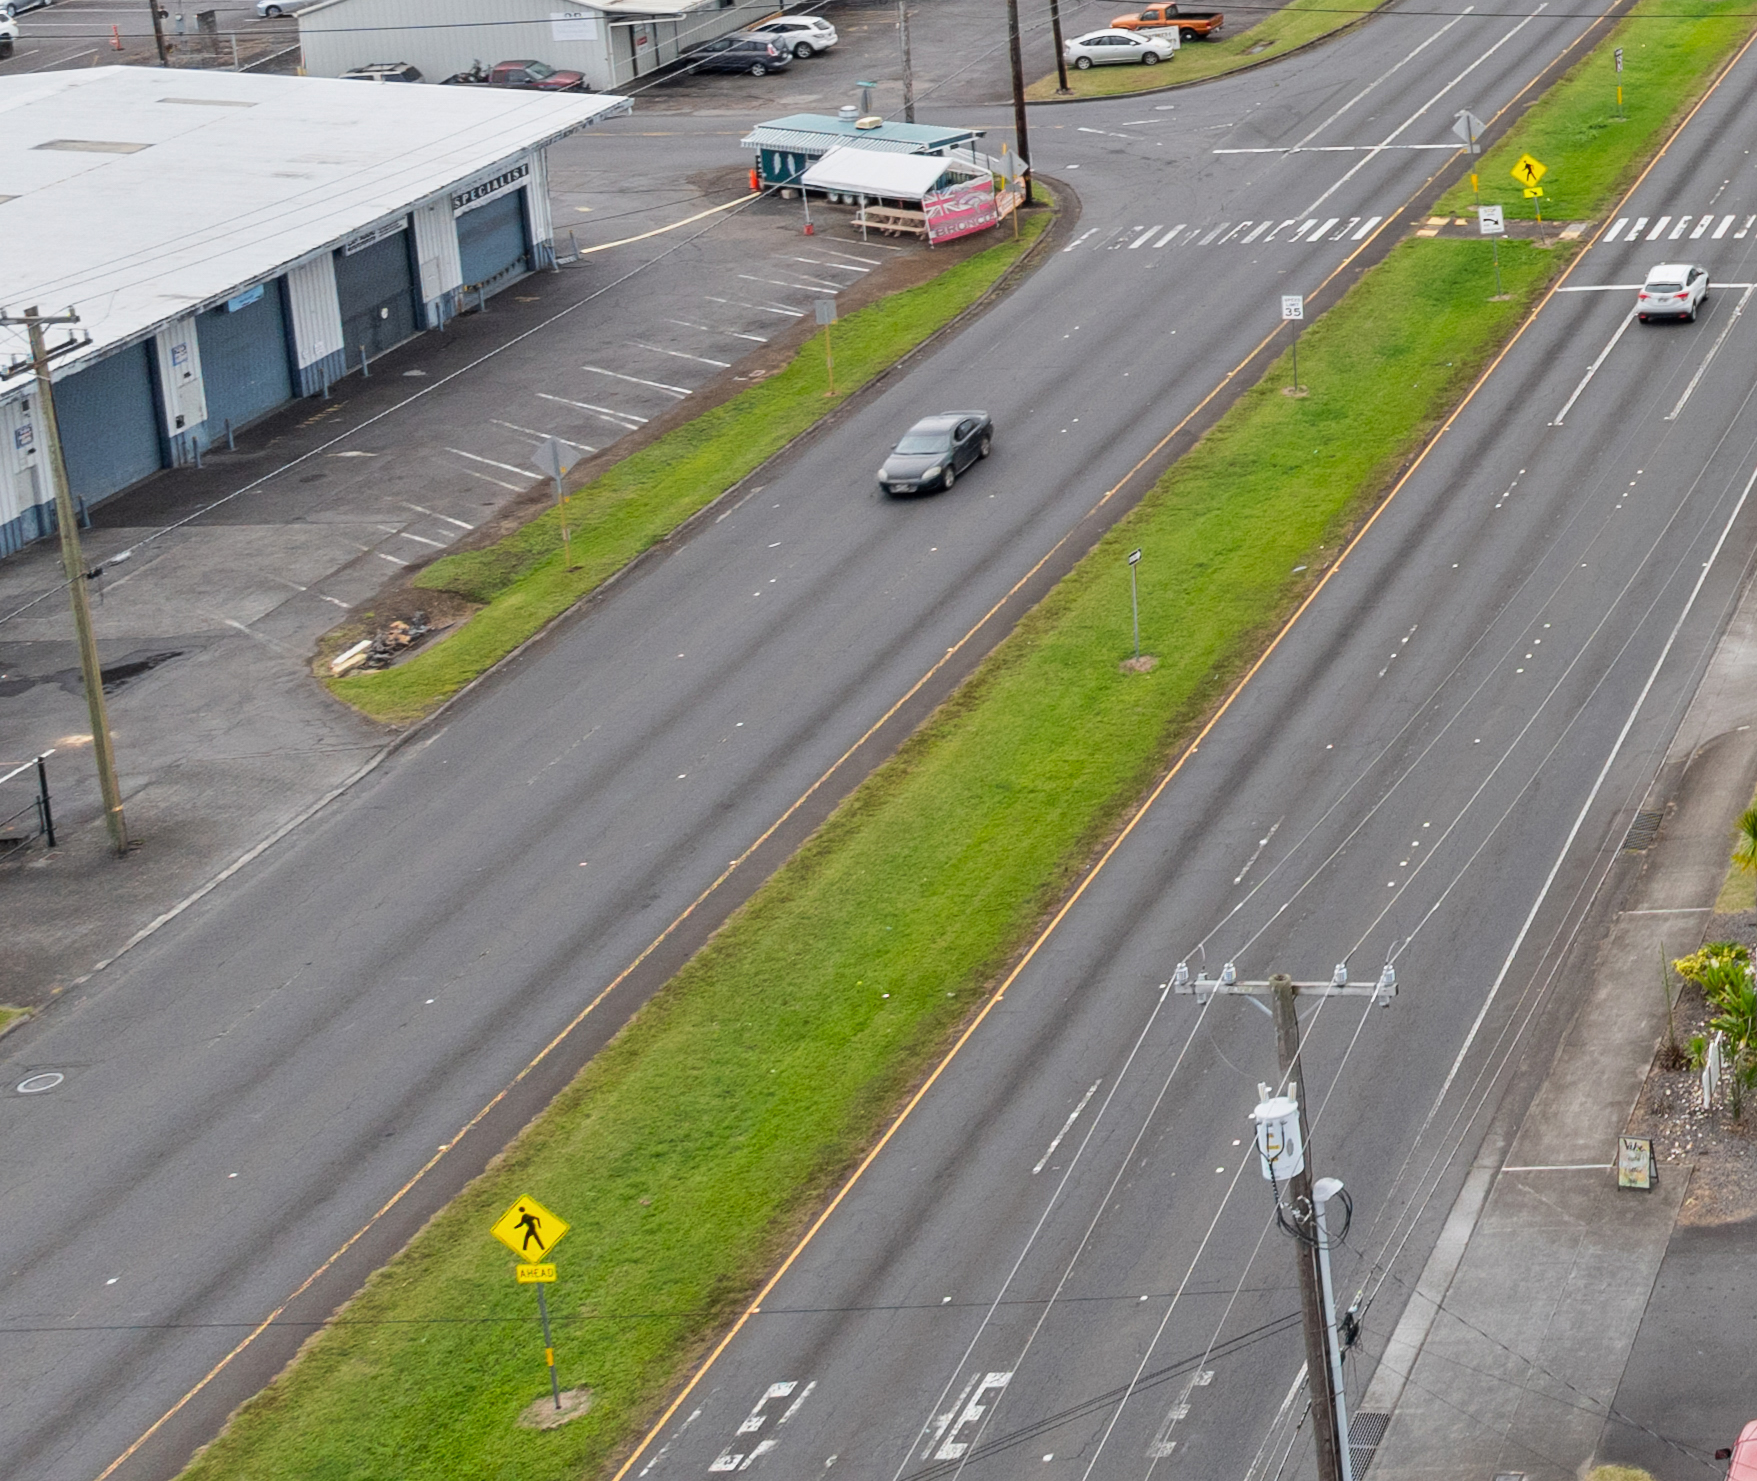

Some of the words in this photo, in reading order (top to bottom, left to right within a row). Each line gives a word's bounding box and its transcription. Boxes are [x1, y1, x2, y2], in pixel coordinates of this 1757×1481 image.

[454, 164, 527, 209] SPECIALIST
[1285, 308, 1301, 316] 35
[520, 1268, 554, 1278] AHEAD
